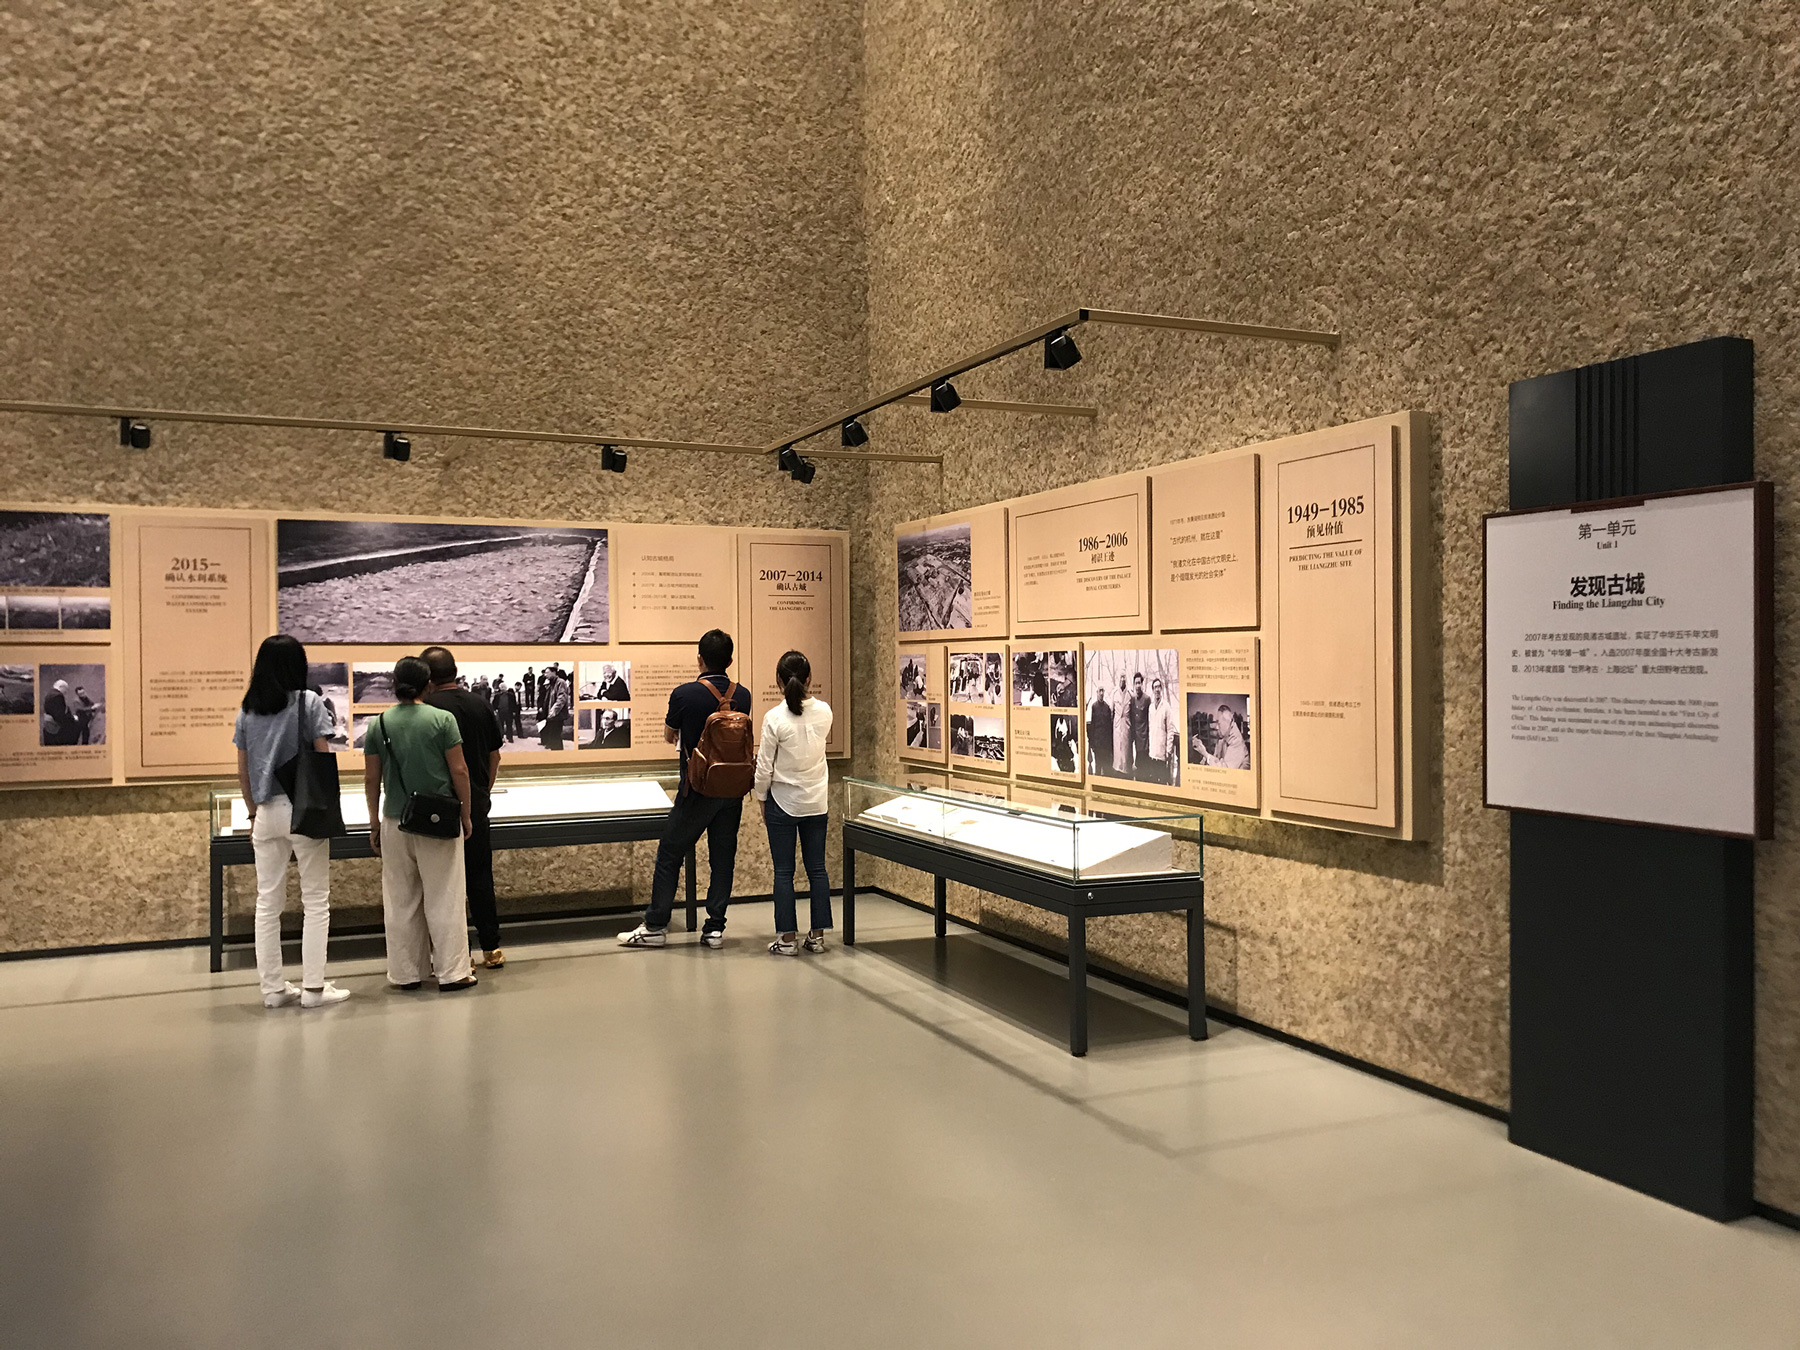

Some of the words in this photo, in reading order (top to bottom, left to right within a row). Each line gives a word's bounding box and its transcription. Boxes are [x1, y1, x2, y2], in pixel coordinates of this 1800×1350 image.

[1287, 494, 1364, 524] 1949–1985
[1306, 520, 1343, 538] 预见价值
[1578, 519, 1636, 540] 第一单元
[1079, 531, 1128, 552] 1986–2006
[1596, 541, 1612, 550] Unit
[1289, 553, 1321, 562] PREDICTING
[1310, 561, 1338, 570] LIANGZHU
[759, 570, 823, 581] 2007–2014
[776, 583, 807, 591] 确认古城
[1570, 572, 1646, 598] 发现古城
[1552, 600, 1584, 611] Finding
[1586, 599, 1599, 608] the
[1602, 598, 1643, 609] Liangzhu
[1645, 596, 1665, 608] City
